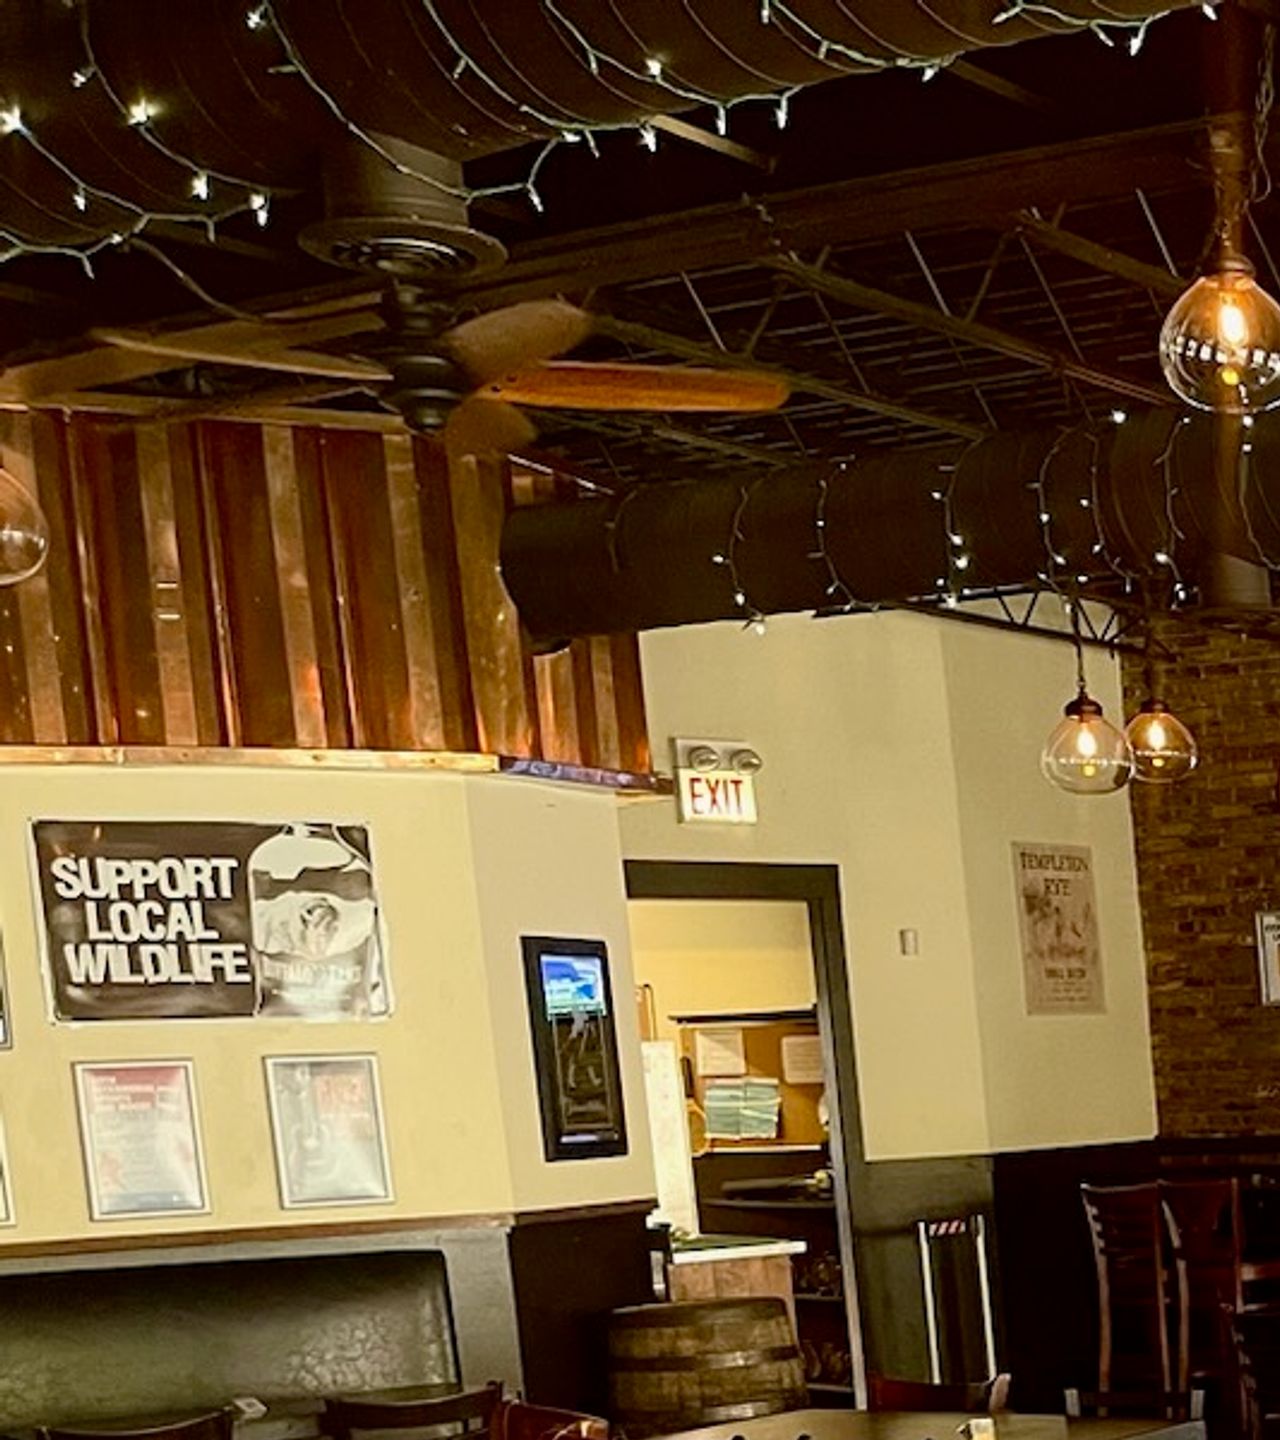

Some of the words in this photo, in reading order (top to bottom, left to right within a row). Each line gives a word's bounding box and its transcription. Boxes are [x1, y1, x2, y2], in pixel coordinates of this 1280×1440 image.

[688, 777, 744, 816] EXIT
[51, 856, 239, 901] SUPPORT
[84, 899, 220, 942] LOCAL
[62, 942, 253, 985] WILDLIFE
